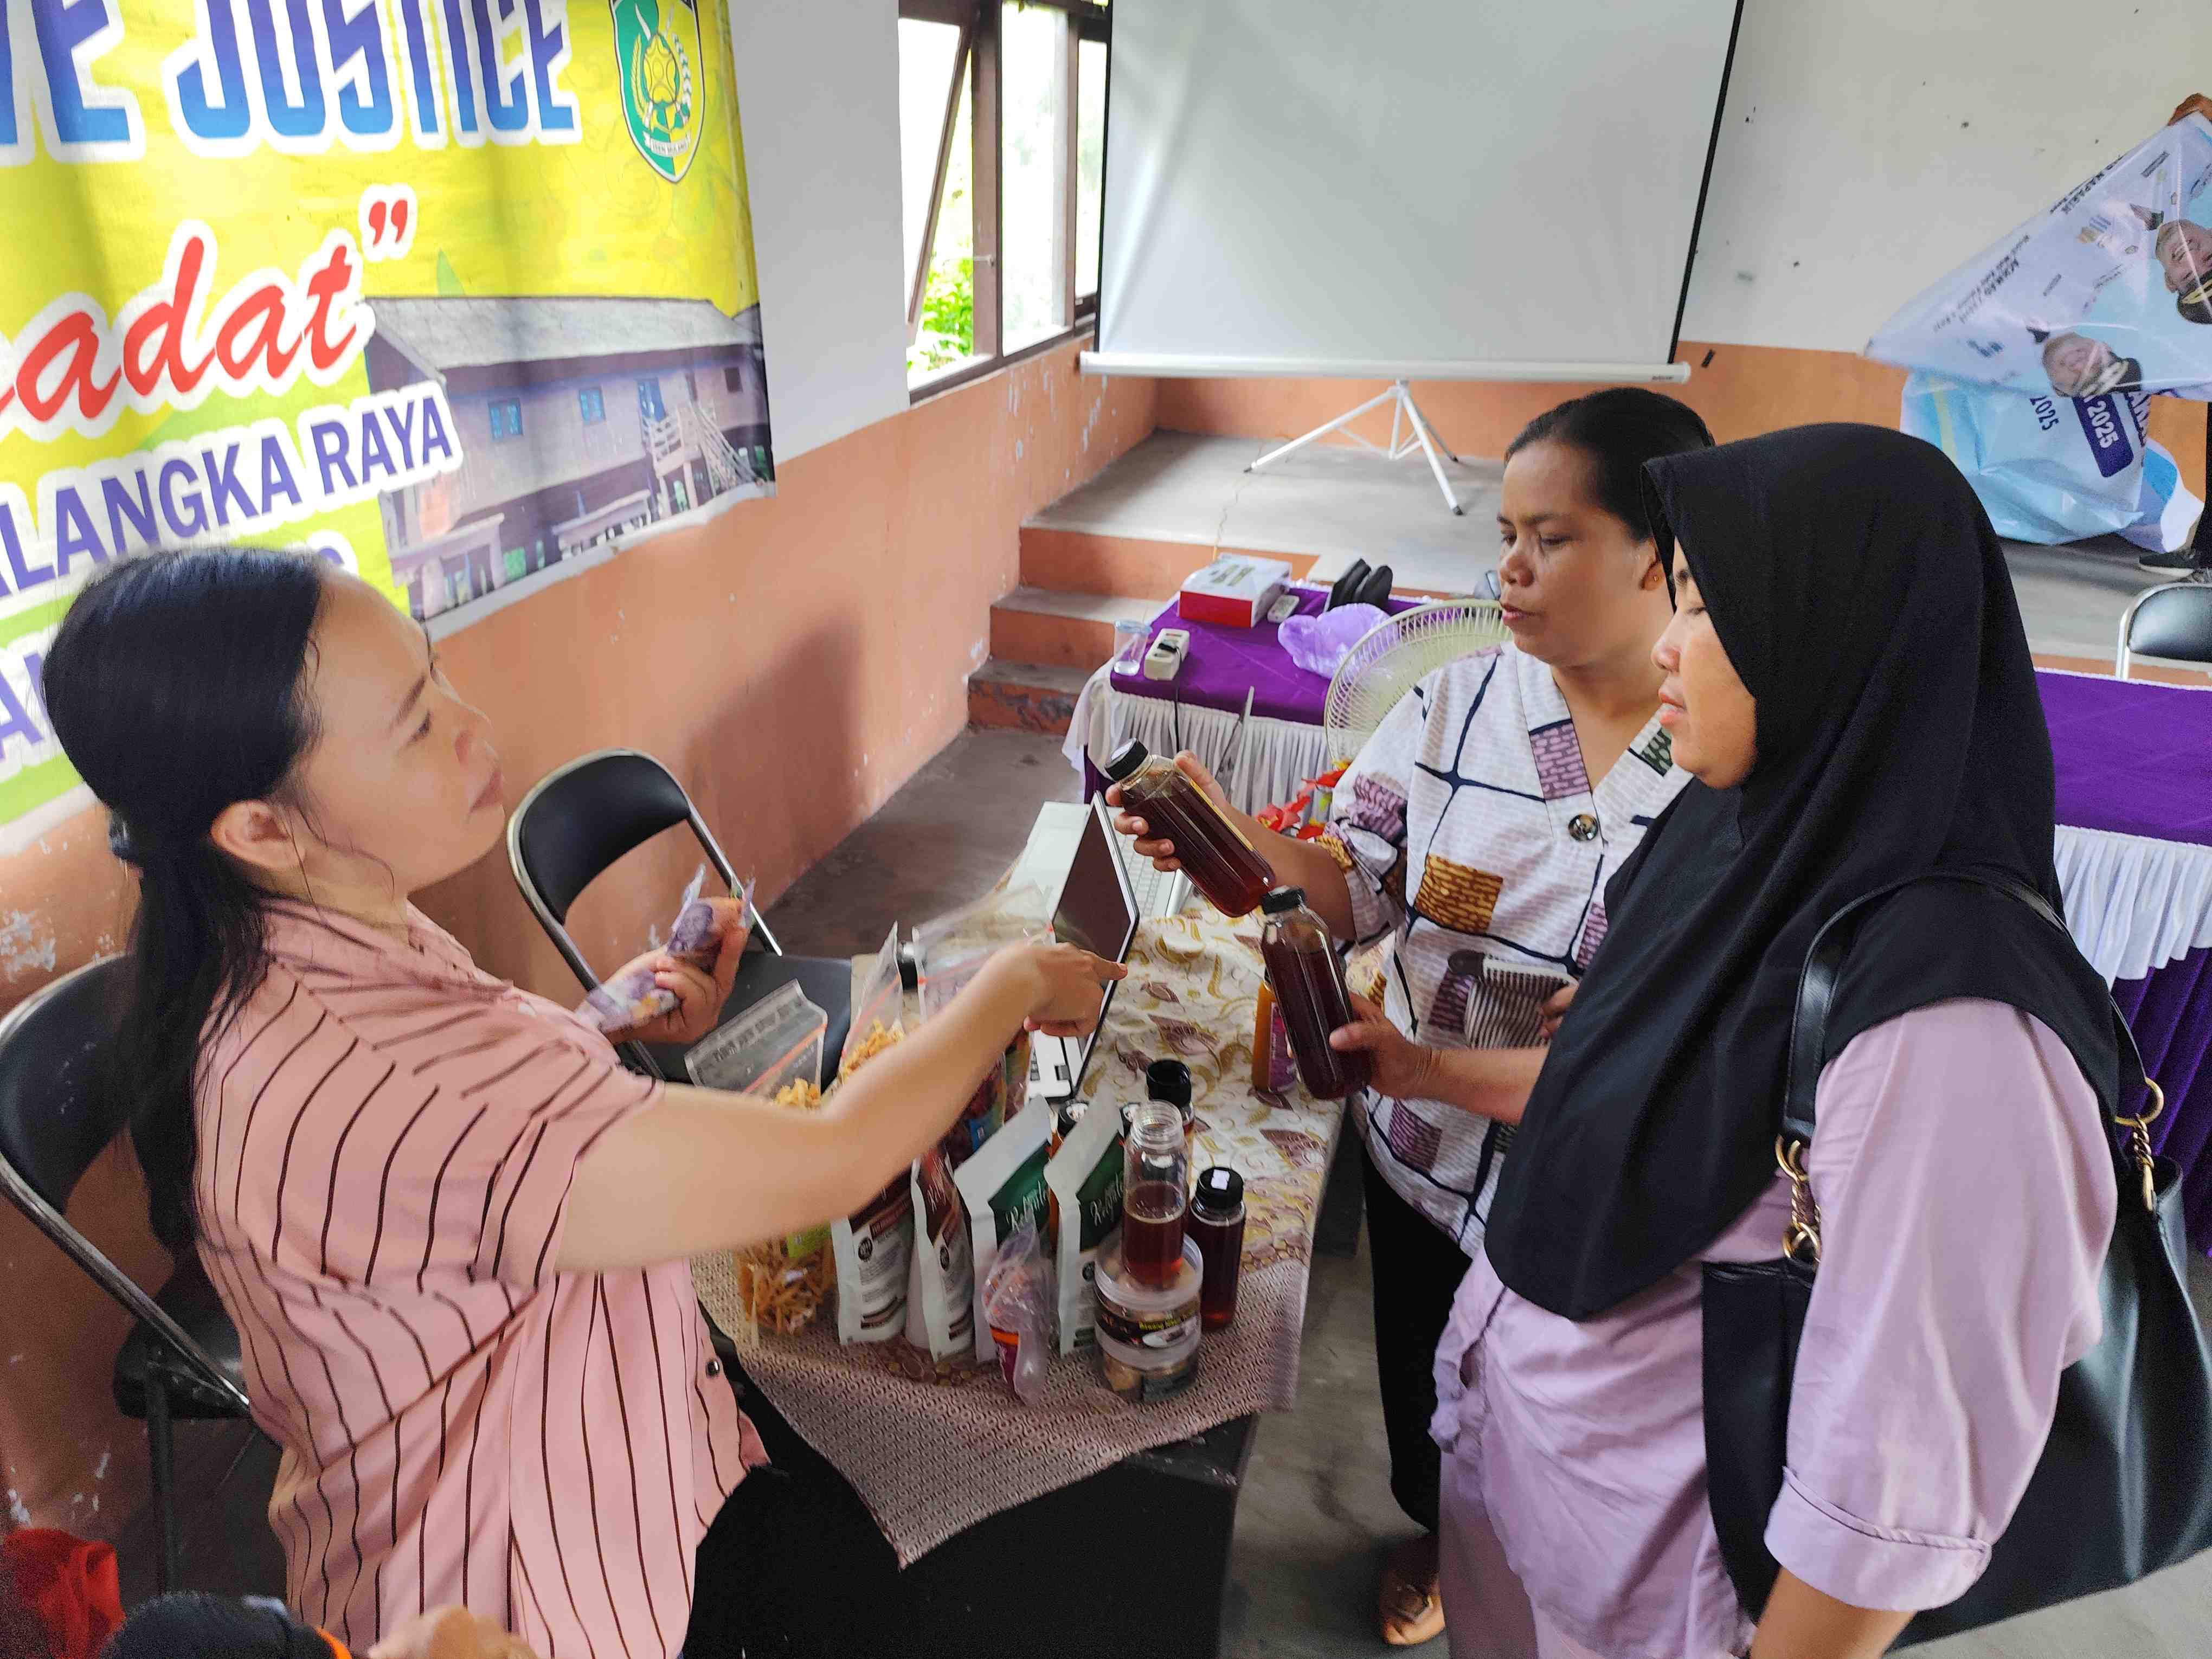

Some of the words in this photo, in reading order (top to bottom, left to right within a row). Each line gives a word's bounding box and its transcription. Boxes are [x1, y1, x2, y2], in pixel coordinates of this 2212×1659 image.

[0, 0, 131, 145] E
[0, 434, 303, 596] LANGKA
[310, 395, 454, 497] RAYA
[2087, 400, 2119, 449] 2025
